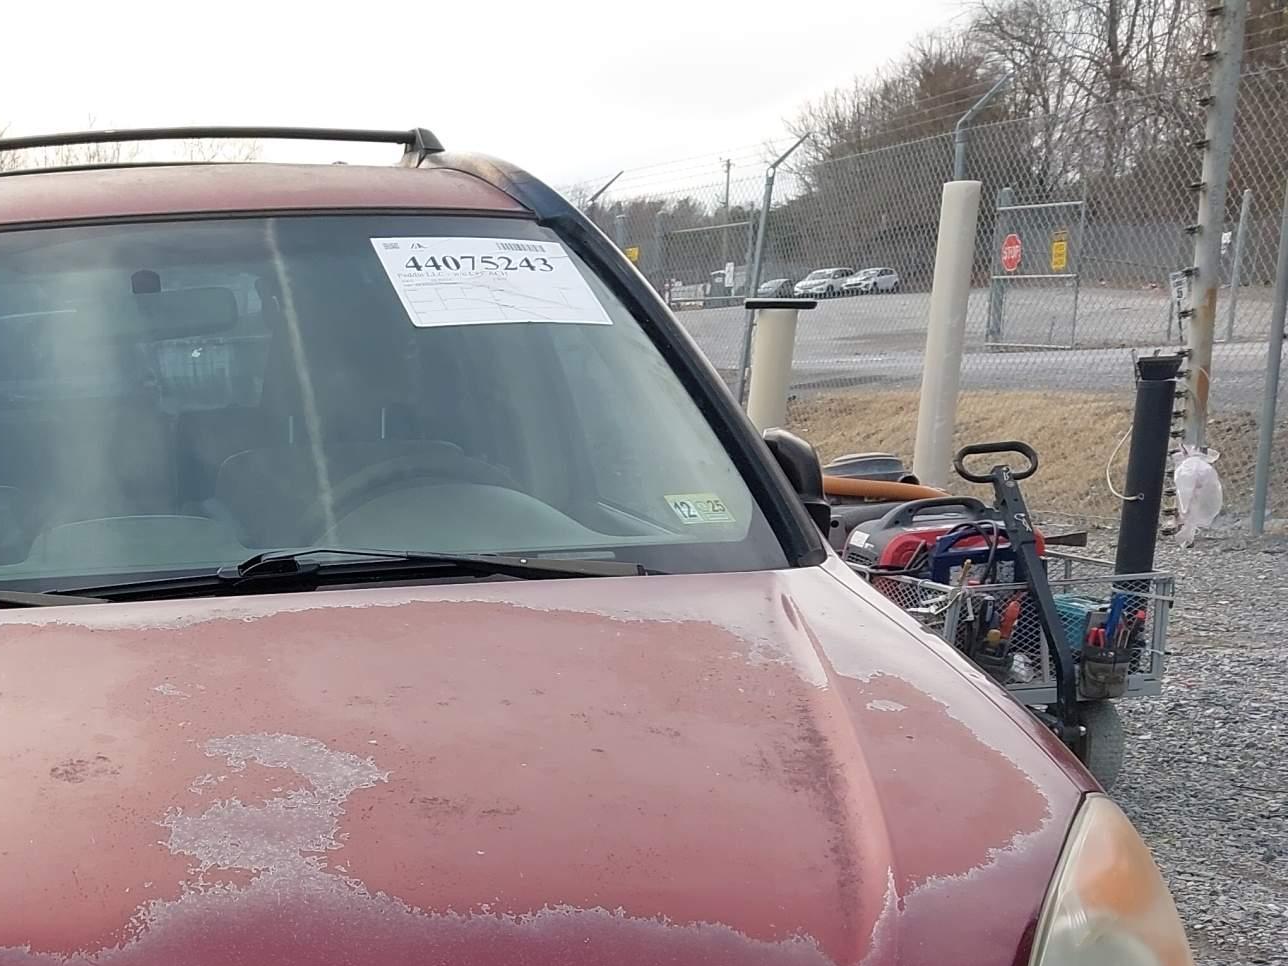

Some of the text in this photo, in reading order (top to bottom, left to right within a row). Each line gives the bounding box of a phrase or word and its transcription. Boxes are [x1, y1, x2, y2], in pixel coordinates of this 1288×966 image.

[406, 255, 554, 272] 44075243
[674, 500, 726, 518] 12 25
